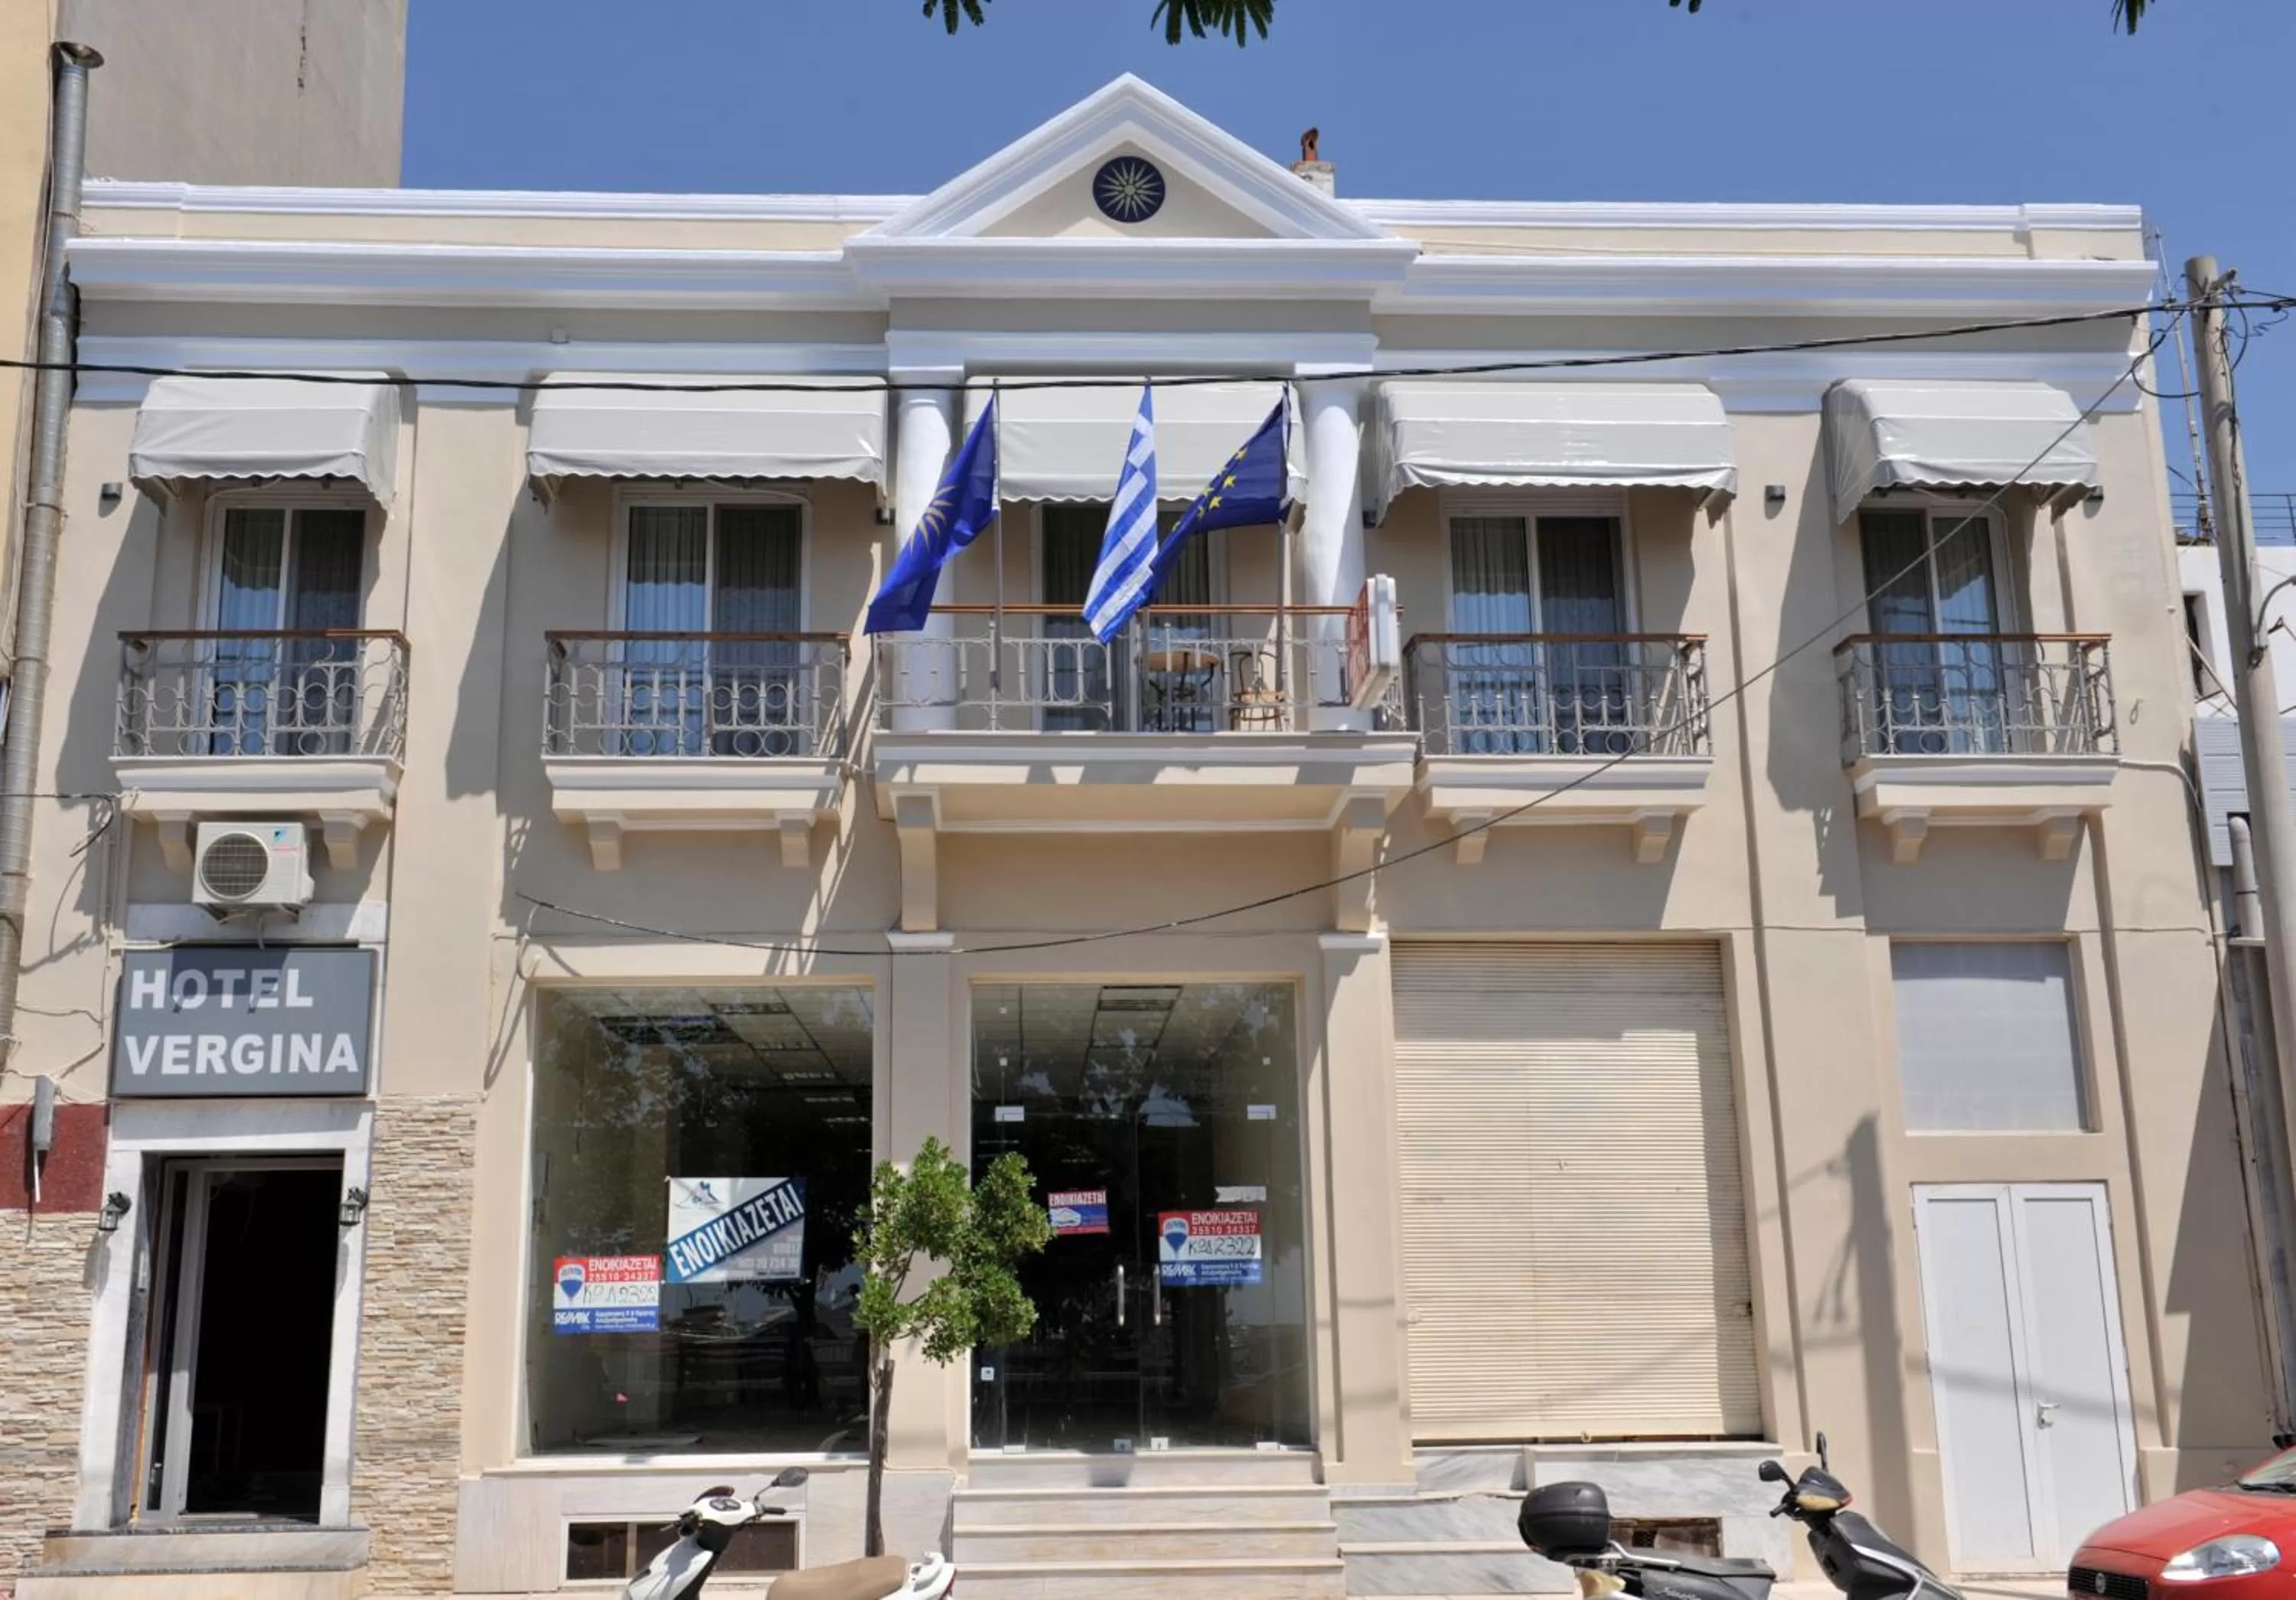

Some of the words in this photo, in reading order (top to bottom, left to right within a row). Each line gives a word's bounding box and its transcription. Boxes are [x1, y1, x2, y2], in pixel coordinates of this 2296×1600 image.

[130, 968, 313, 1009] HOTEL
[124, 1033, 359, 1075] VERGINA
[669, 1183, 804, 1278] ΕΝΟΙΚΙΑΖΕΤΑΙ
[1192, 1212, 1257, 1225] ΕΝΟΙΚΙΑΖΕΤΑΙ
